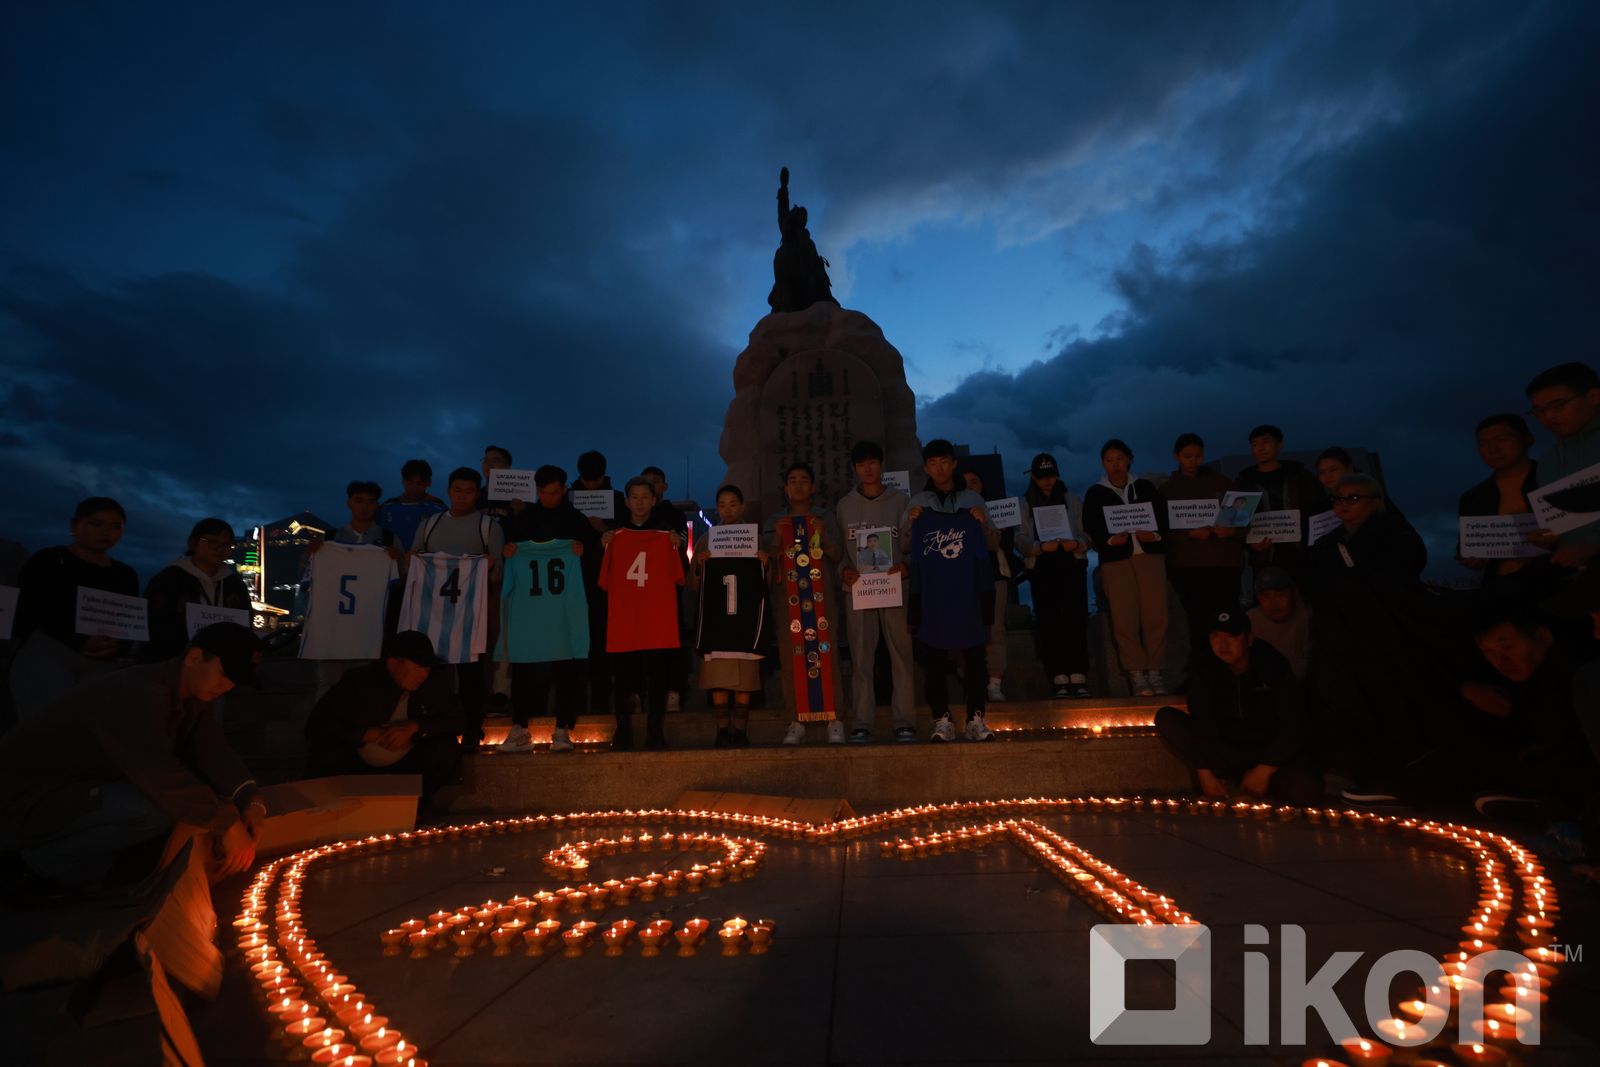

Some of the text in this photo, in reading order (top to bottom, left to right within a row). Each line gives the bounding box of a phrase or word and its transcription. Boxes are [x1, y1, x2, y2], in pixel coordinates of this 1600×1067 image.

[439, 567, 461, 603] 4
[529, 558, 565, 597] 16
[626, 551, 649, 587] 4
[862, 578, 891, 586] ХАРГИС
[339, 575, 357, 615] 5
[722, 574, 738, 616] 1
